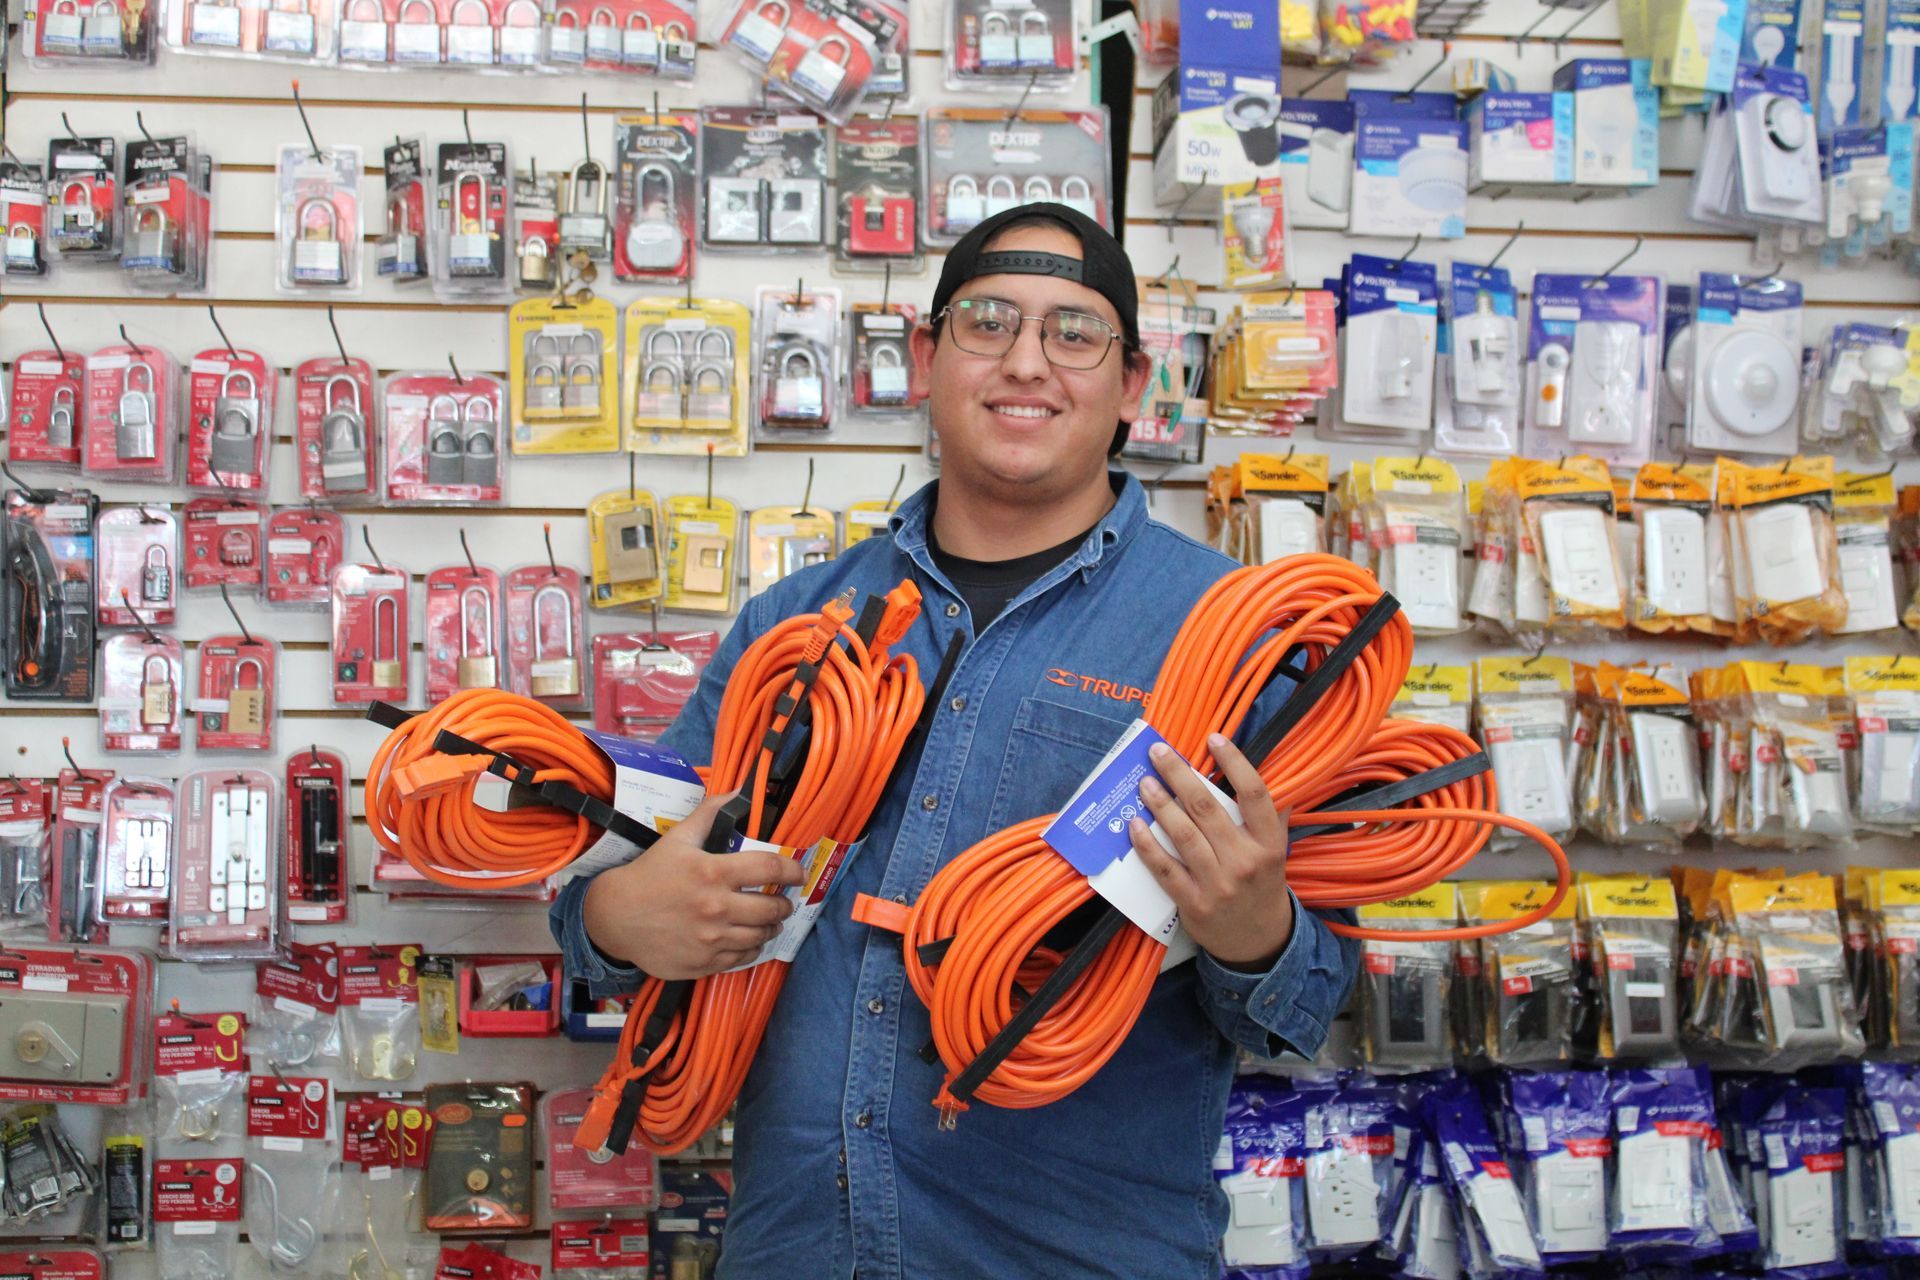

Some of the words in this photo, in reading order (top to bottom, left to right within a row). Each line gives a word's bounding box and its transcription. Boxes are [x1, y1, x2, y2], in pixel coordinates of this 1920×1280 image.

[1217, 11, 1252, 19] VOLTECK
[1592, 65, 1627, 75] VOLTECK
[1497, 101, 1531, 109] VOLTECK
[637, 135, 676, 147] DEXTER
[989, 132, 1041, 146] DEXTER
[1365, 276, 1396, 287] VOLTECK
[1547, 297, 1578, 305] VOLTECK
[1134, 421, 1157, 440] 15
[1260, 471, 1300, 481] Sanelec
[1401, 470, 1443, 481] Sanelec
[1537, 476, 1579, 487] Sanelec
[1649, 480, 1688, 491] Sanelec
[1758, 478, 1802, 493] Sanelec
[1508, 670, 1555, 682] Sanelec
[1873, 671, 1918, 681] Sanelec
[1079, 675, 1153, 707] TRUPE
[1410, 681, 1453, 692] Sanelec
[1634, 686, 1665, 696] Sanelec
[1389, 898, 1436, 908] Sanelec
[1617, 897, 1659, 907] Sanelec
[26, 964, 66, 973] CERRADURA
[1516, 962, 1552, 976] Sanelec
[1660, 1104, 1706, 1114] VOLTECK
